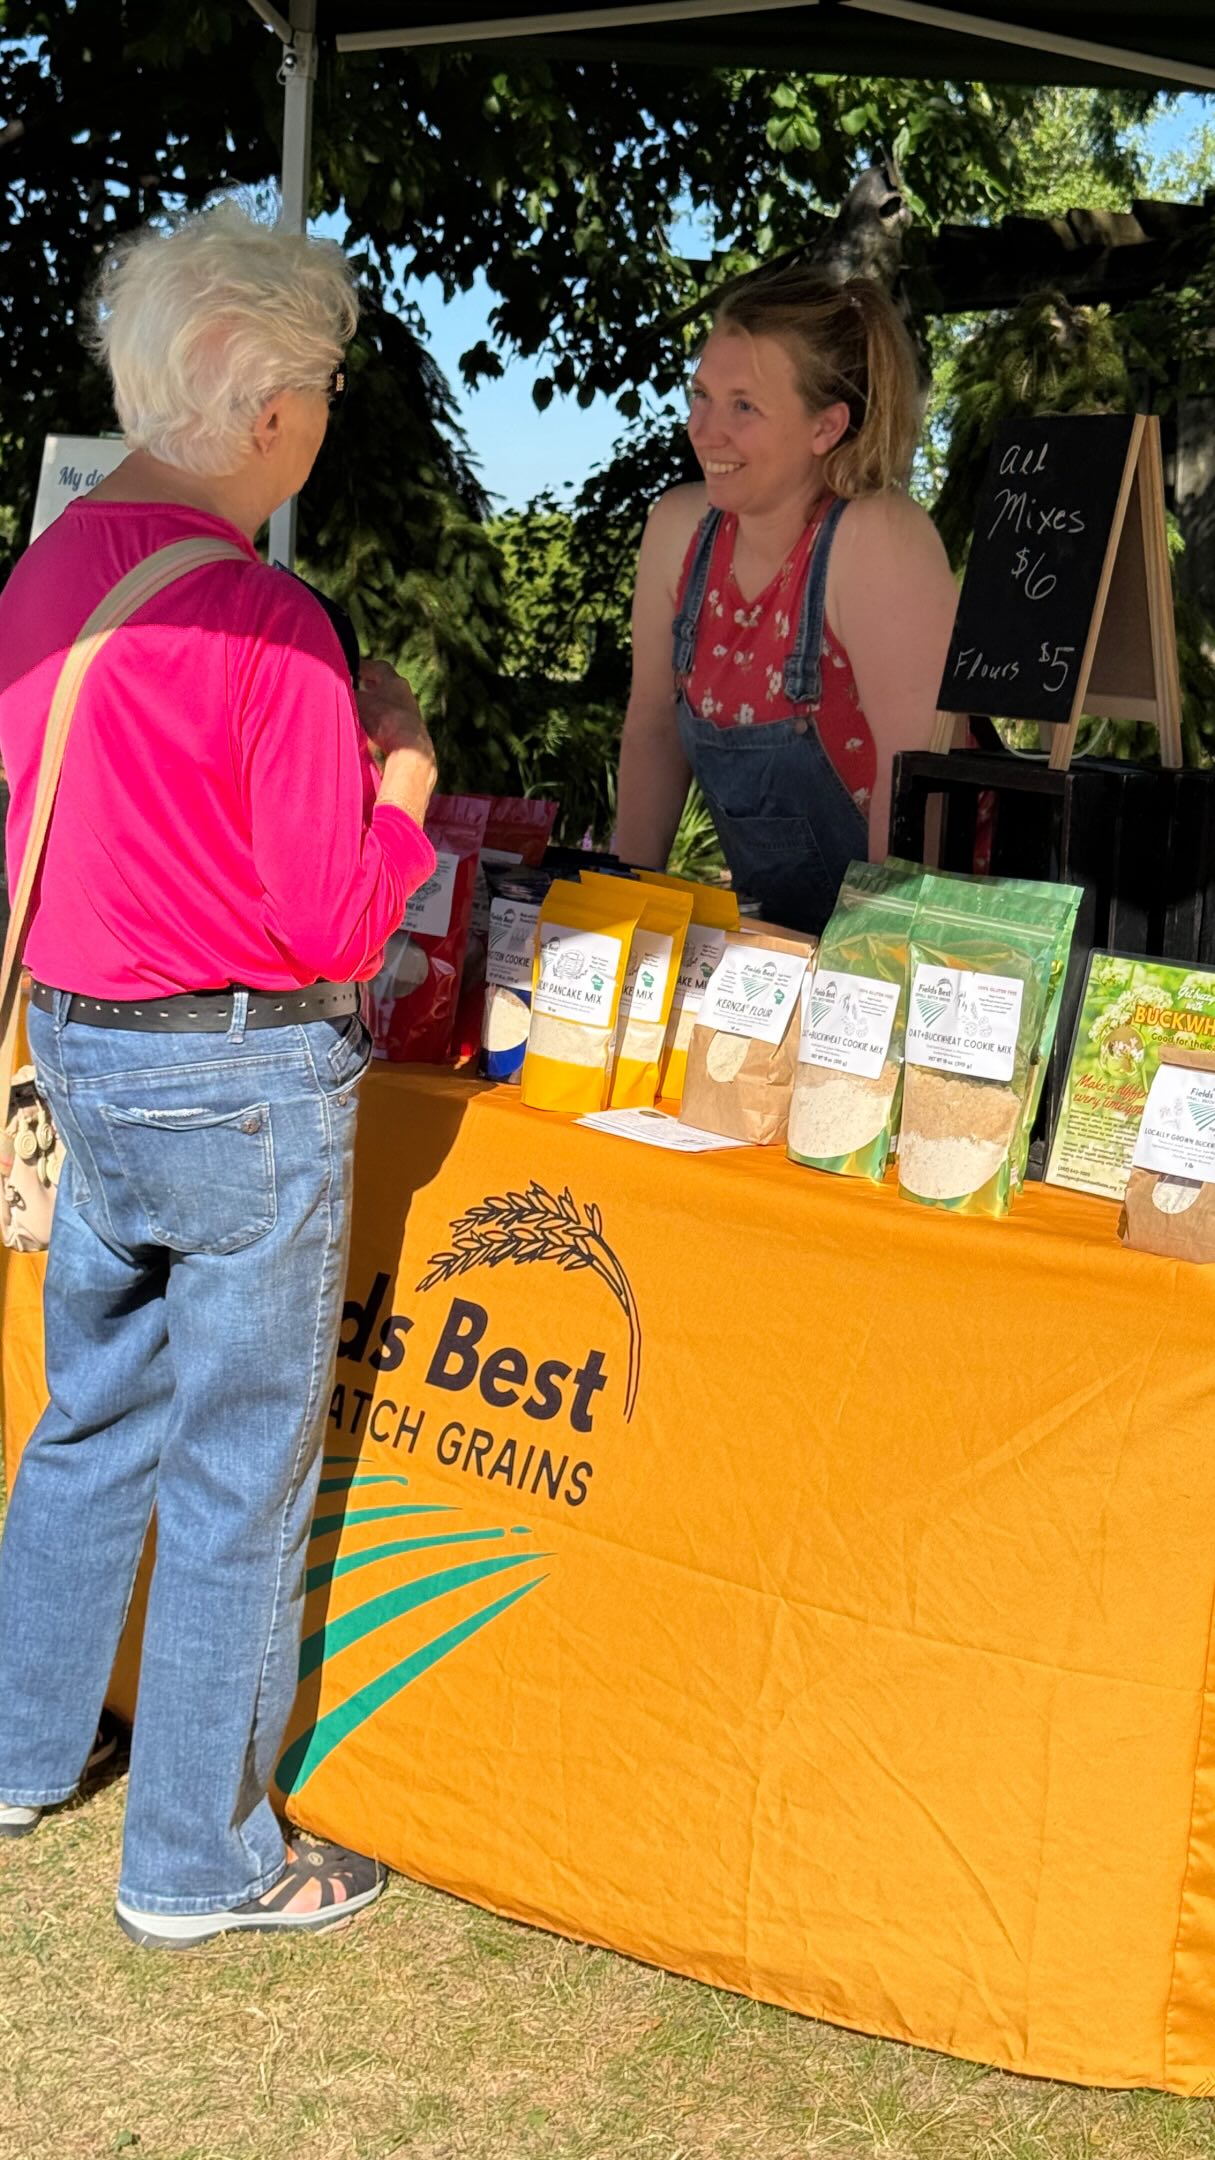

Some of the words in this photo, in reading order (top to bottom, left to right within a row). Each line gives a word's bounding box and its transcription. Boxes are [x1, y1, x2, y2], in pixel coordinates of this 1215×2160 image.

[58, 466, 83, 492] My
[988, 489, 1085, 541] Mixes
[1011, 547, 1057, 600] $6
[1038, 642, 1075, 692] $5
[505, 954, 530, 967] COOKIE
[549, 983, 582, 1001] PANCAKE
[585, 992, 602, 1004] MIX
[636, 989, 654, 1000] MIX
[919, 984, 937, 995] Fields
[938, 987, 951, 998] Best
[749, 1006, 773, 1018] FLOUR
[842, 1038, 869, 1052] COOKIE
[870, 1044, 884, 1055] MIX
[963, 1039, 996, 1052] COOKIE
[997, 1045, 1012, 1055] MIX
[1151, 1032, 1174, 1044] Good
[1175, 1036, 1188, 1046] for
[1075, 1073, 1105, 1092] Make
[1107, 1085, 1115, 1094] a
[1072, 1093, 1100, 1110] every
[1190, 1087, 1213, 1099] Fields
[1144, 1127, 1170, 1138] LOCALLY
[1171, 1134, 1194, 1145] GROWN
[425, 1297, 607, 1432] Best
[329, 1385, 425, 1454] ATCH
[437, 1421, 594, 1507] GRAINS
